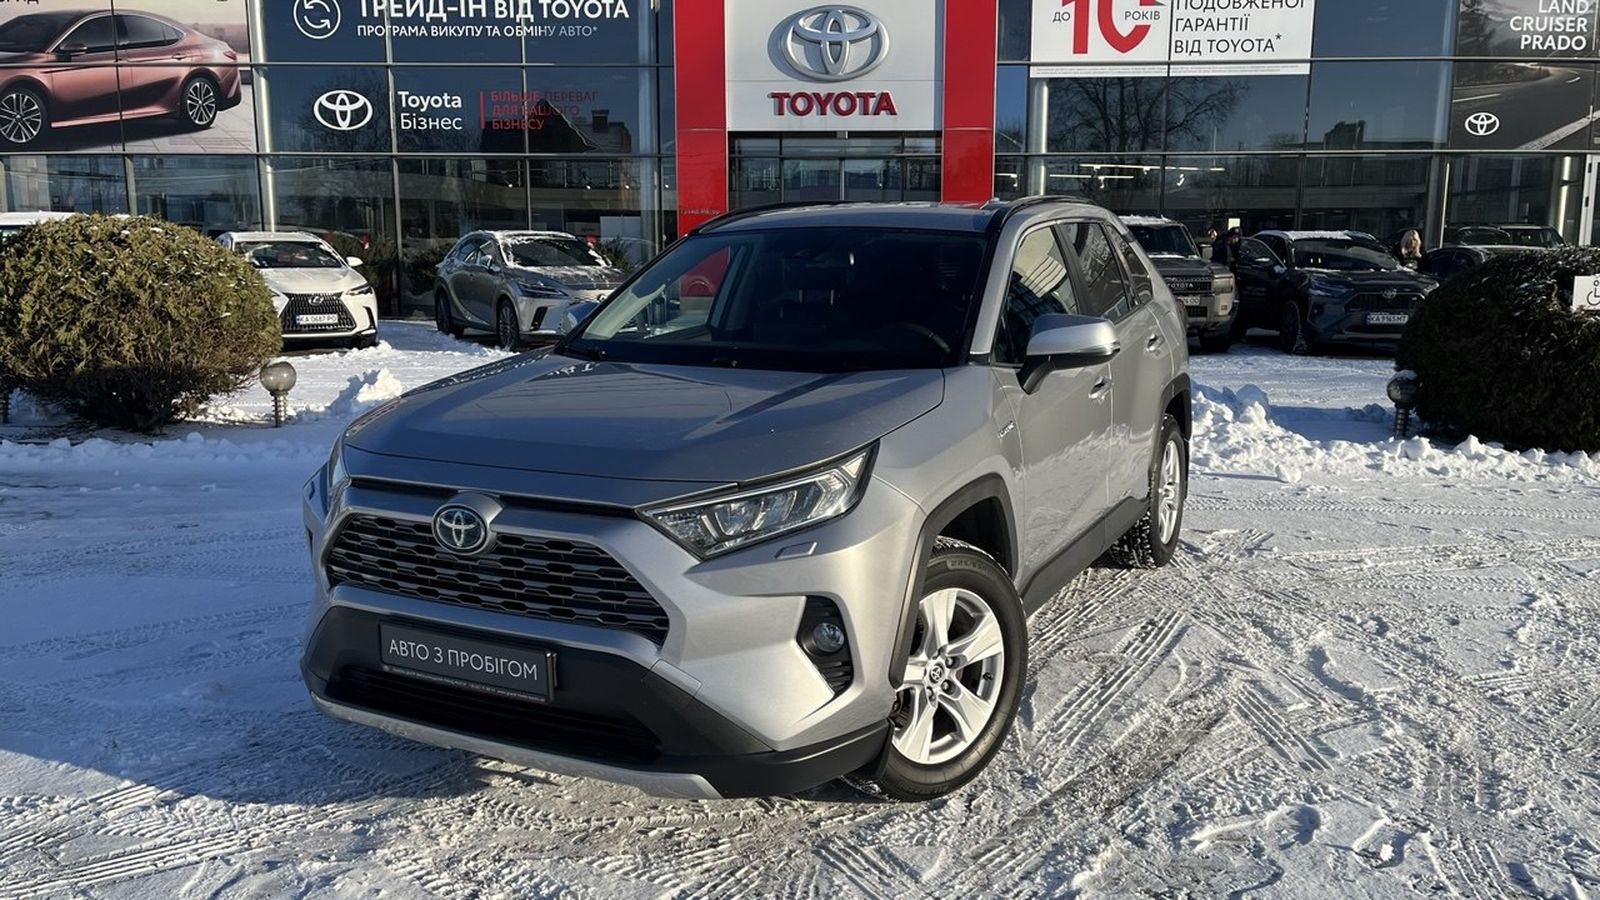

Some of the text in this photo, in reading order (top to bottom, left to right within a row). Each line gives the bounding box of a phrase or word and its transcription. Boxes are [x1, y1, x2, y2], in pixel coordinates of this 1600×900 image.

[361, 0, 630, 23] ТРЕЙД-ІН ВІД TOYOTA
[1538, 0, 1589, 14] LAND
[1052, 11, 1071, 23] ДО
[1124, 10, 1161, 21] РОКІВ
[1175, 13, 1250, 32] ГАРАНТІЇ
[1509, 15, 1588, 33] CRUISER
[357, 25, 428, 37] ПРОГРАМА
[430, 25, 483, 37] ВИКУПУ
[485, 25, 501, 37] ТА
[503, 25, 556, 37] ОБМІНУ
[1174, 39, 1202, 56] ВІД
[1520, 34, 1587, 51] PRADO
[397, 91, 462, 112] Toyota
[768, 91, 898, 117] TOYOTA
[400, 113, 463, 130] Бізнес
[492, 118, 545, 131] БІЗНЕСУ
[389, 639, 538, 681] АВТО З ПРОБІГОМ
